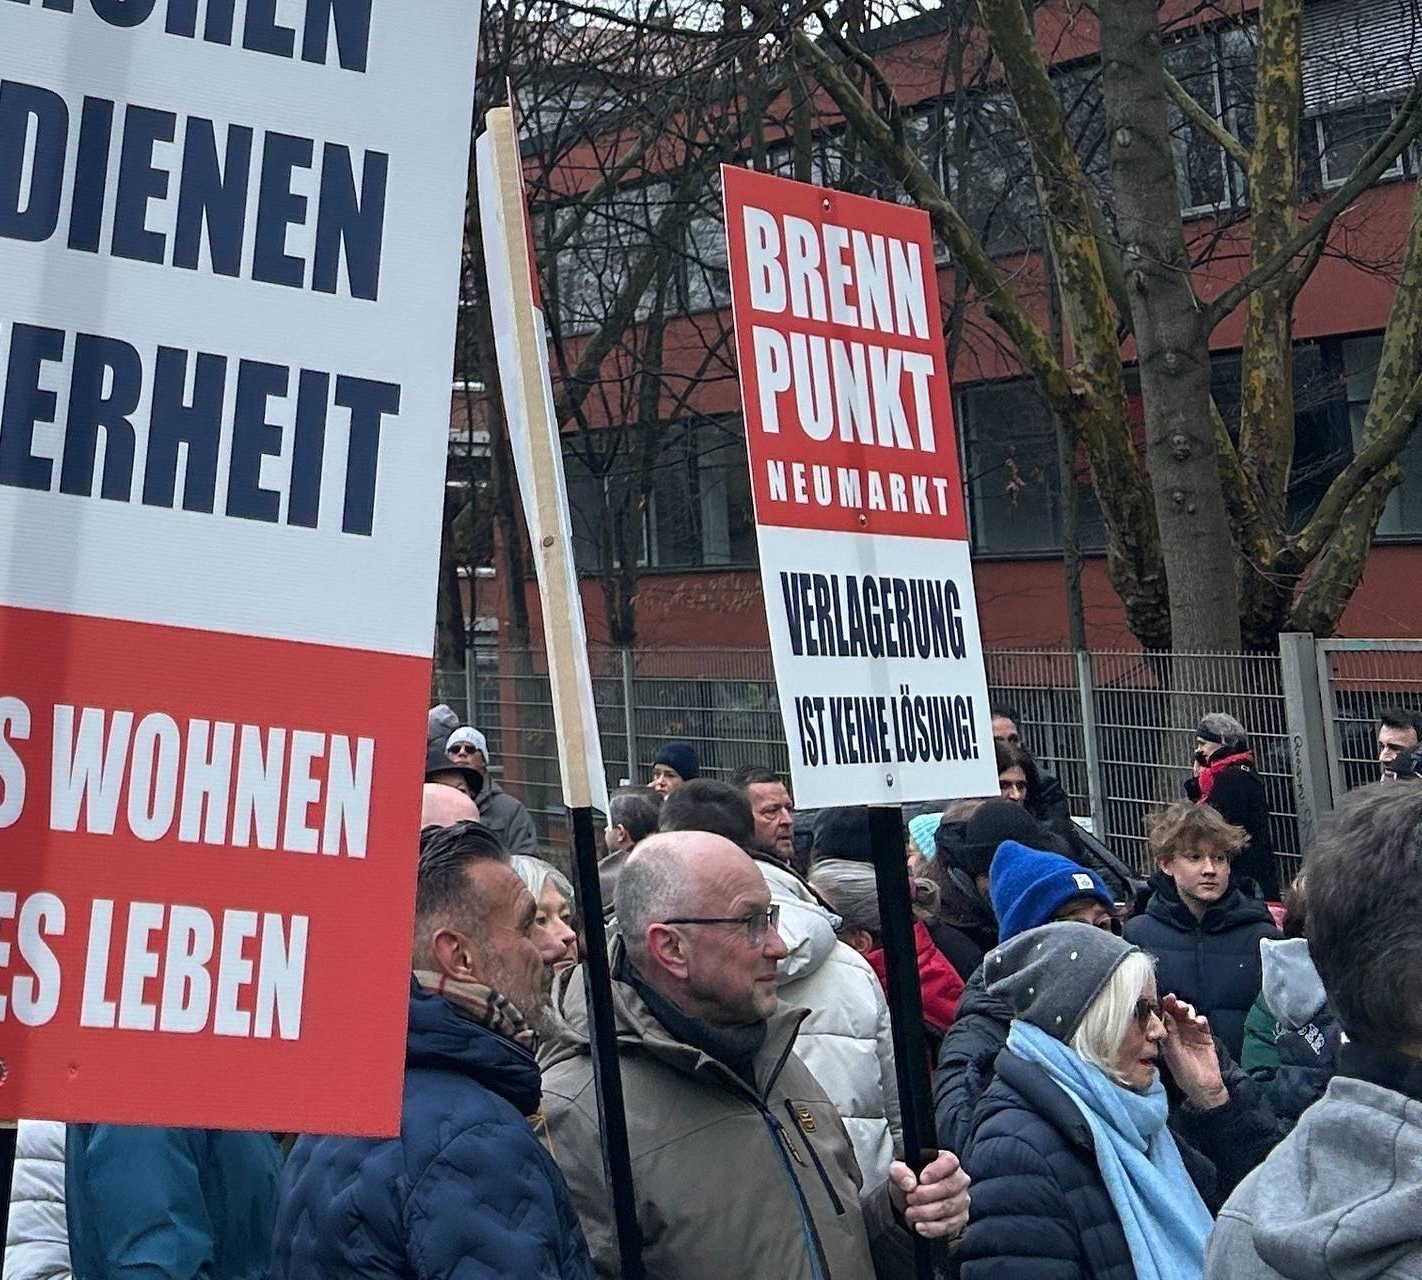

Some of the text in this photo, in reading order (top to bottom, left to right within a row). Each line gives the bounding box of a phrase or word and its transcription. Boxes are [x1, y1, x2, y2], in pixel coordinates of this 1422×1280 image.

[742, 205, 930, 340] BRENN
[752, 325, 936, 453] PUNKT
[766, 459, 949, 516] NEUMARKT
[779, 571, 966, 659] VERLAGERUNG
[49, 704, 374, 859] WOHNEN
[795, 684, 978, 767] IST KEINE LÖSUNG!
[80, 899, 309, 1040] LEBEN
